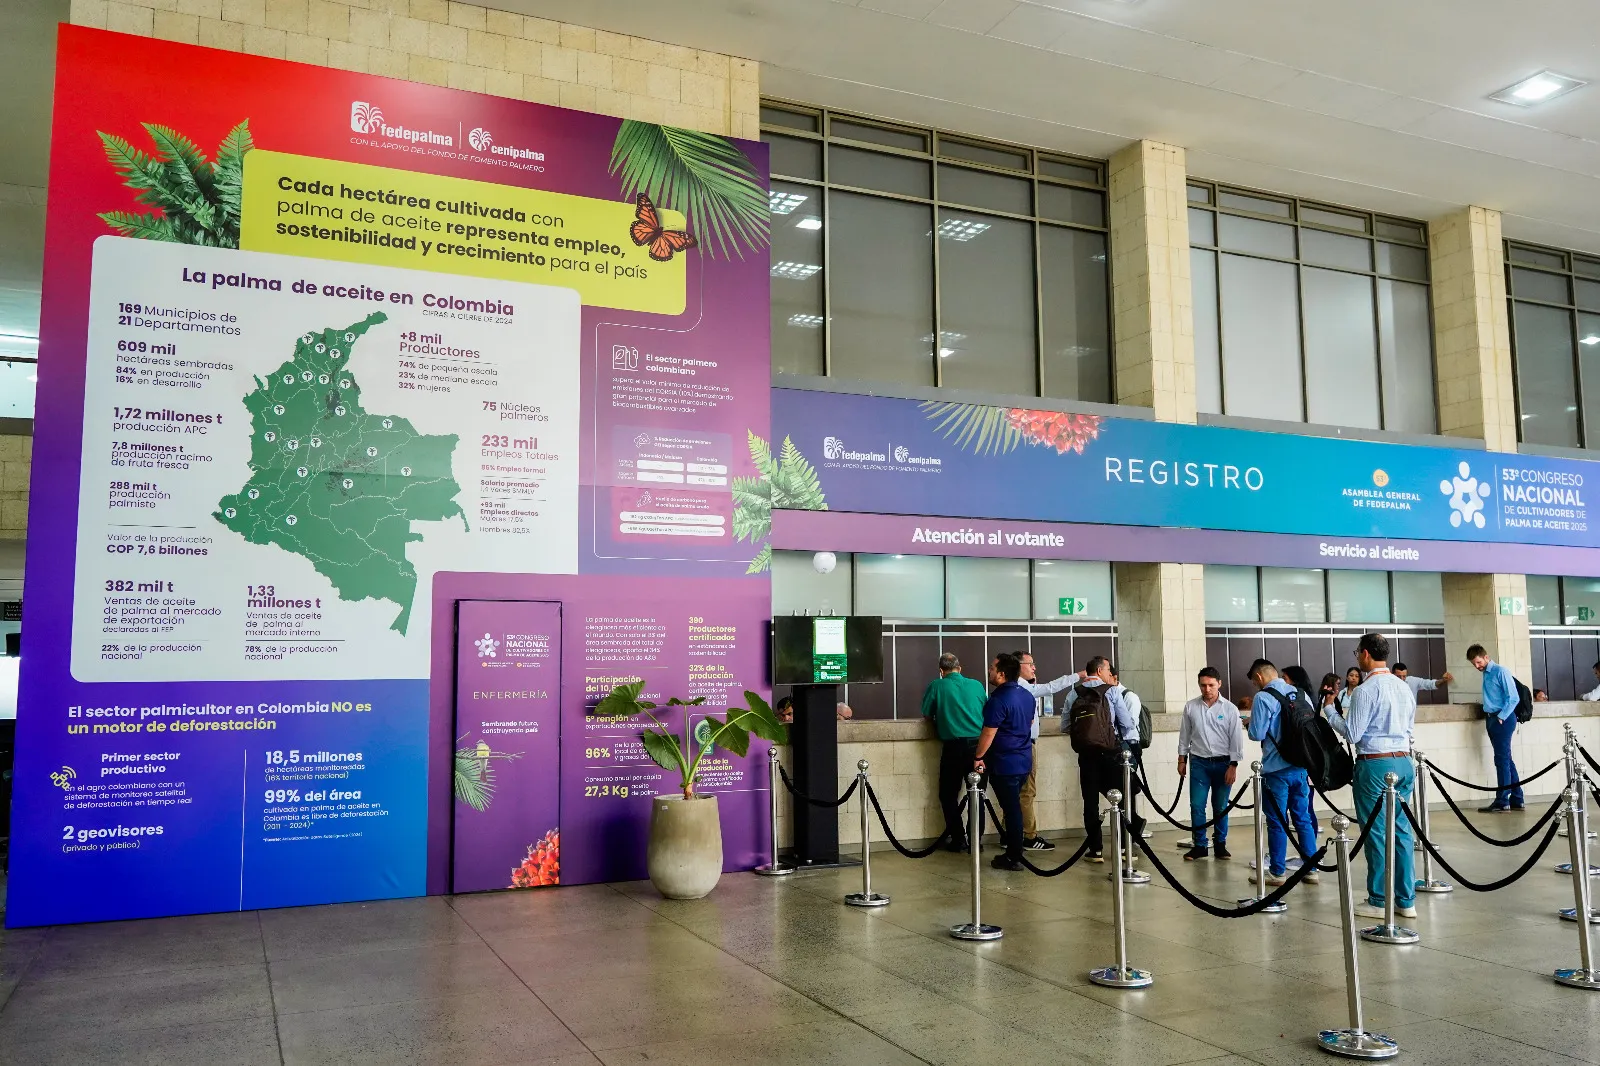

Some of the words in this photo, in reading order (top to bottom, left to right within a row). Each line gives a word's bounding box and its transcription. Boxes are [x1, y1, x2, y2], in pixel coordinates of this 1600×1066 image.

[381, 123, 452, 146] fedepalma
[350, 138, 368, 146] CON
[380, 142, 409, 152] APOYO
[411, 146, 425, 154] DEL
[428, 148, 456, 159] FONDO
[470, 155, 508, 167] FOMENTO
[510, 161, 545, 173] PALMERO
[491, 145, 544, 162] cenipalma
[278, 177, 334, 196] Cada
[341, 184, 430, 209] hectárea
[436, 200, 526, 222] cultivada
[532, 214, 564, 228] con
[278, 201, 343, 219] palma
[351, 208, 375, 223] de
[382, 215, 441, 231] aceite
[447, 222, 549, 246] representa
[554, 238, 625, 258] empleo,
[276, 222, 416, 250] sostenibilidad
[421, 240, 432, 256] y
[437, 242, 546, 265] crecimiento
[551, 257, 589, 271] para
[595, 262, 608, 274] el
[615, 265, 648, 279] país
[183, 268, 206, 284] La
[212, 273, 282, 291] palma
[292, 280, 317, 294] de
[322, 284, 385, 301] aceite
[389, 292, 413, 305] en
[422, 293, 514, 315] Colombia
[119, 303, 141, 314] 169
[144, 305, 216, 322] Municipios
[220, 312, 237, 323] de
[118, 316, 132, 326] 21
[135, 317, 241, 336] Departamentos
[401, 332, 416, 342] +8
[421, 333, 441, 344] mil
[118, 340, 147, 352] 609
[151, 344, 176, 356] mil
[400, 342, 480, 358] Productores
[655, 355, 681, 364] sector
[683, 358, 717, 368] palmero
[646, 365, 696, 375] colombiano
[399, 382, 415, 390] 32%
[418, 384, 451, 393] mujeres
[483, 401, 497, 411] 75
[500, 402, 540, 413] Núcleos
[114, 407, 141, 420] 1,72
[146, 409, 212, 424] millones
[217, 414, 223, 424] t
[500, 411, 549, 422] palmeros
[114, 422, 181, 434] producción
[184, 425, 207, 435] APC
[112, 442, 127, 451] 7,8
[131, 443, 176, 452] millones
[179, 445, 184, 453] t
[482, 435, 508, 447] 233
[514, 437, 537, 449] mil
[482, 449, 522, 459] Empleos
[526, 451, 559, 461] Totales
[842, 451, 885, 464] fedepalma
[908, 457, 941, 466] cenipalma
[1106, 457, 1263, 490] REGISTRO
[1521, 470, 1583, 487] CONGRESO
[110, 482, 130, 490] 288
[133, 482, 150, 491] mil
[153, 483, 157, 491] t
[1342, 489, 1384, 499] ASAMBLEA
[1386, 491, 1420, 501] GENERAL
[1503, 485, 1585, 507] NACIONAL
[1366, 500, 1411, 510] FEDEPALMA
[1504, 505, 1515, 515] DE
[1517, 506, 1574, 518] CULTIVADORES
[1576, 511, 1586, 519] DE
[1506, 518, 1531, 528] PALMA
[1532, 520, 1542, 528] DE
[1544, 520, 1569, 530] ACEITE
[1571, 522, 1587, 531] 2025
[912, 528, 984, 544] Atención
[988, 530, 1001, 544] al
[1005, 531, 1064, 547] votante
[107, 545, 134, 554] COP
[138, 545, 155, 556] 7,6
[159, 546, 208, 555] billones
[1320, 543, 1367, 559] Servicio
[1370, 544, 1380, 559] al
[1382, 546, 1419, 560] cliente
[105, 580, 134, 592] 382
[138, 581, 162, 593] mil
[167, 583, 174, 593] t
[248, 585, 275, 598] 1,33
[104, 597, 142, 606] Ventas
[146, 597, 159, 605] de
[163, 598, 196, 606] aceite
[248, 597, 312, 608] millones
[315, 598, 321, 609] t
[104, 607, 118, 615] de
[122, 607, 157, 617] palma
[160, 607, 170, 615] al
[173, 608, 222, 616] mercado
[104, 616, 117, 624] de
[121, 616, 185, 627] exportación
[586, 675, 641, 685] Participación
[689, 672, 734, 681] producción
[474, 690, 548, 699] ENFERMERÍA
[69, 706, 82, 718] El
[86, 706, 137, 718] sector
[141, 703, 232, 719] palmicultor
[236, 705, 254, 715] en
[258, 702, 329, 714] Colombia
[332, 702, 353, 713] NO
[356, 703, 372, 712] es
[597, 714, 628, 724] renglón
[68, 724, 89, 734] un
[93, 722, 143, 734] motor
[146, 721, 166, 733] de
[170, 718, 276, 733] deforestación
[102, 753, 141, 763] Primer
[144, 751, 181, 761] sector
[266, 750, 300, 766] 18,5
[303, 751, 363, 763] millones
[586, 748, 610, 758] 96%
[101, 764, 166, 777] productivo
[264, 789, 300, 803] 99%
[305, 790, 326, 802] del
[329, 789, 362, 800] área
[585, 785, 609, 798] 27,3
[612, 785, 628, 798] Kg
[63, 826, 74, 840] 2
[78, 825, 164, 842] geovisores
[63, 844, 98, 853] (privado
[107, 840, 140, 851] público)
